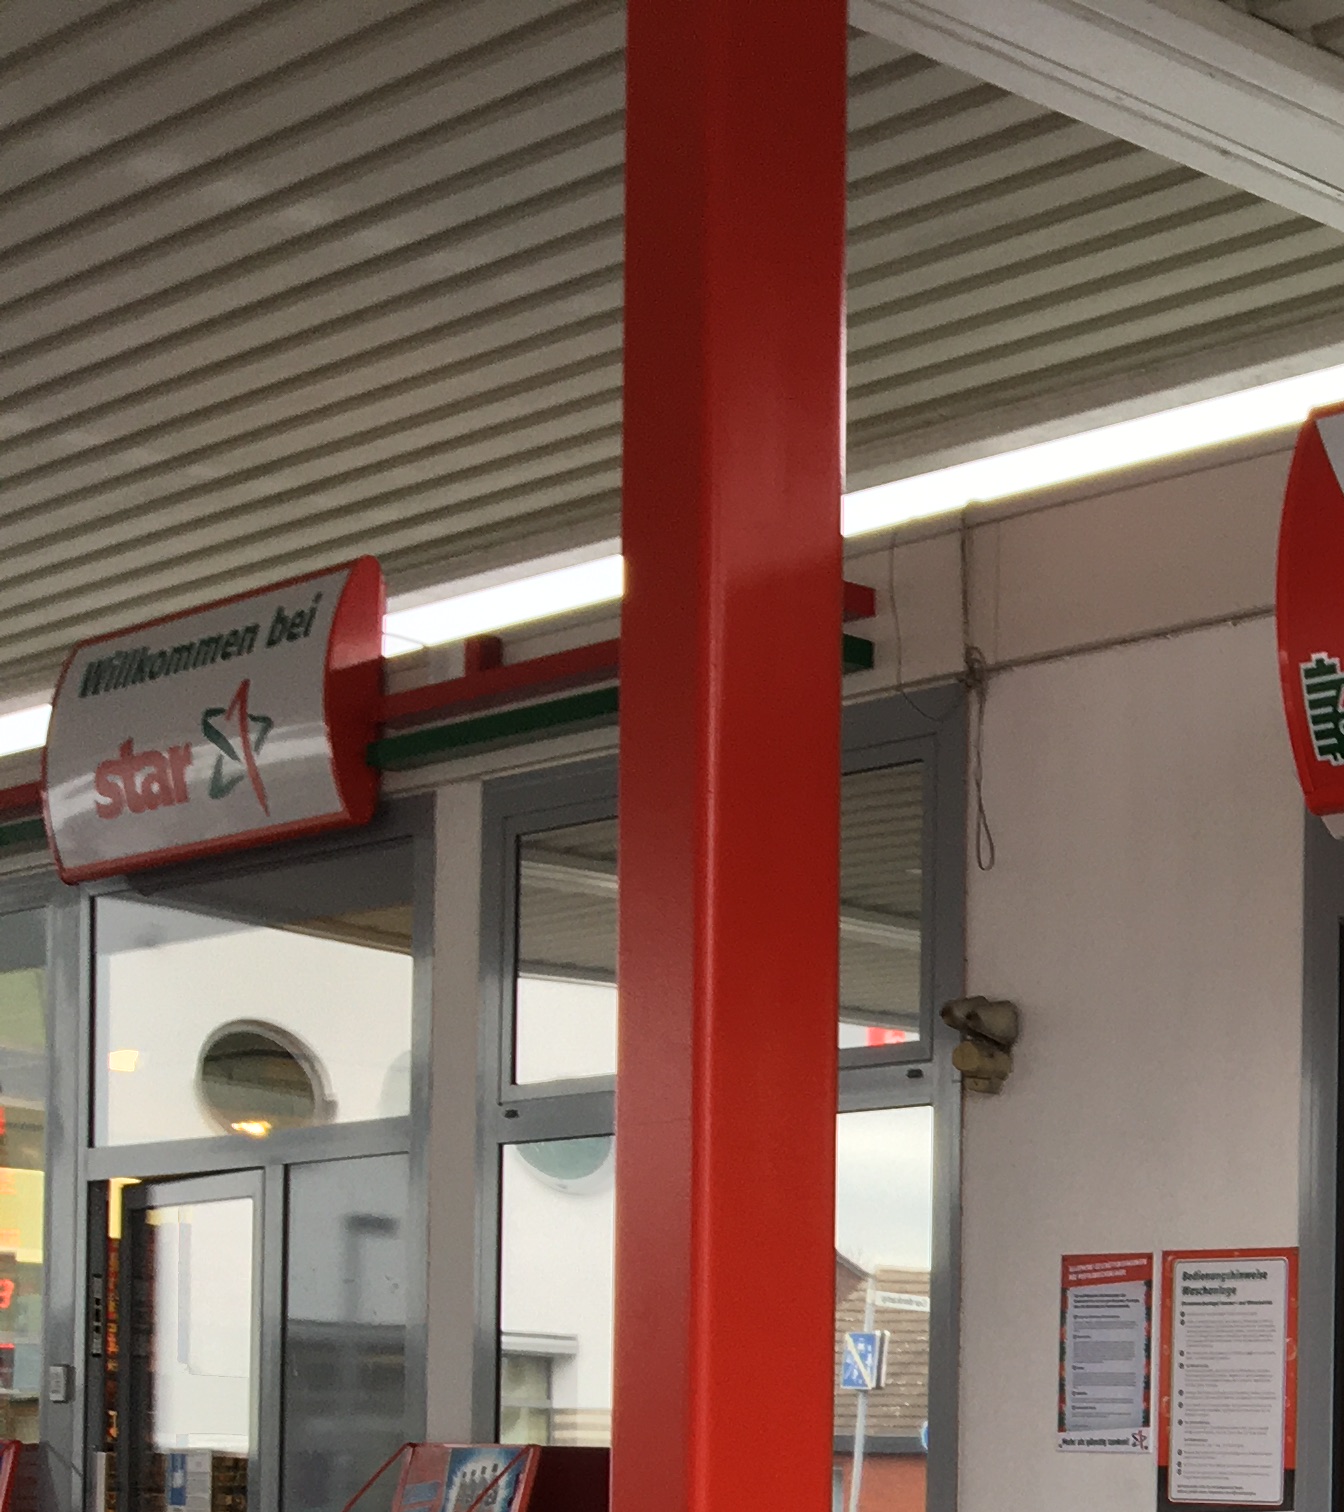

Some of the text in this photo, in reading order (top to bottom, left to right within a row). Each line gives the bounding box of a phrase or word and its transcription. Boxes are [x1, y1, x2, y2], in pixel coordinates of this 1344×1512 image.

[78, 591, 323, 698] Willkommen bei
[95, 737, 194, 819] star
